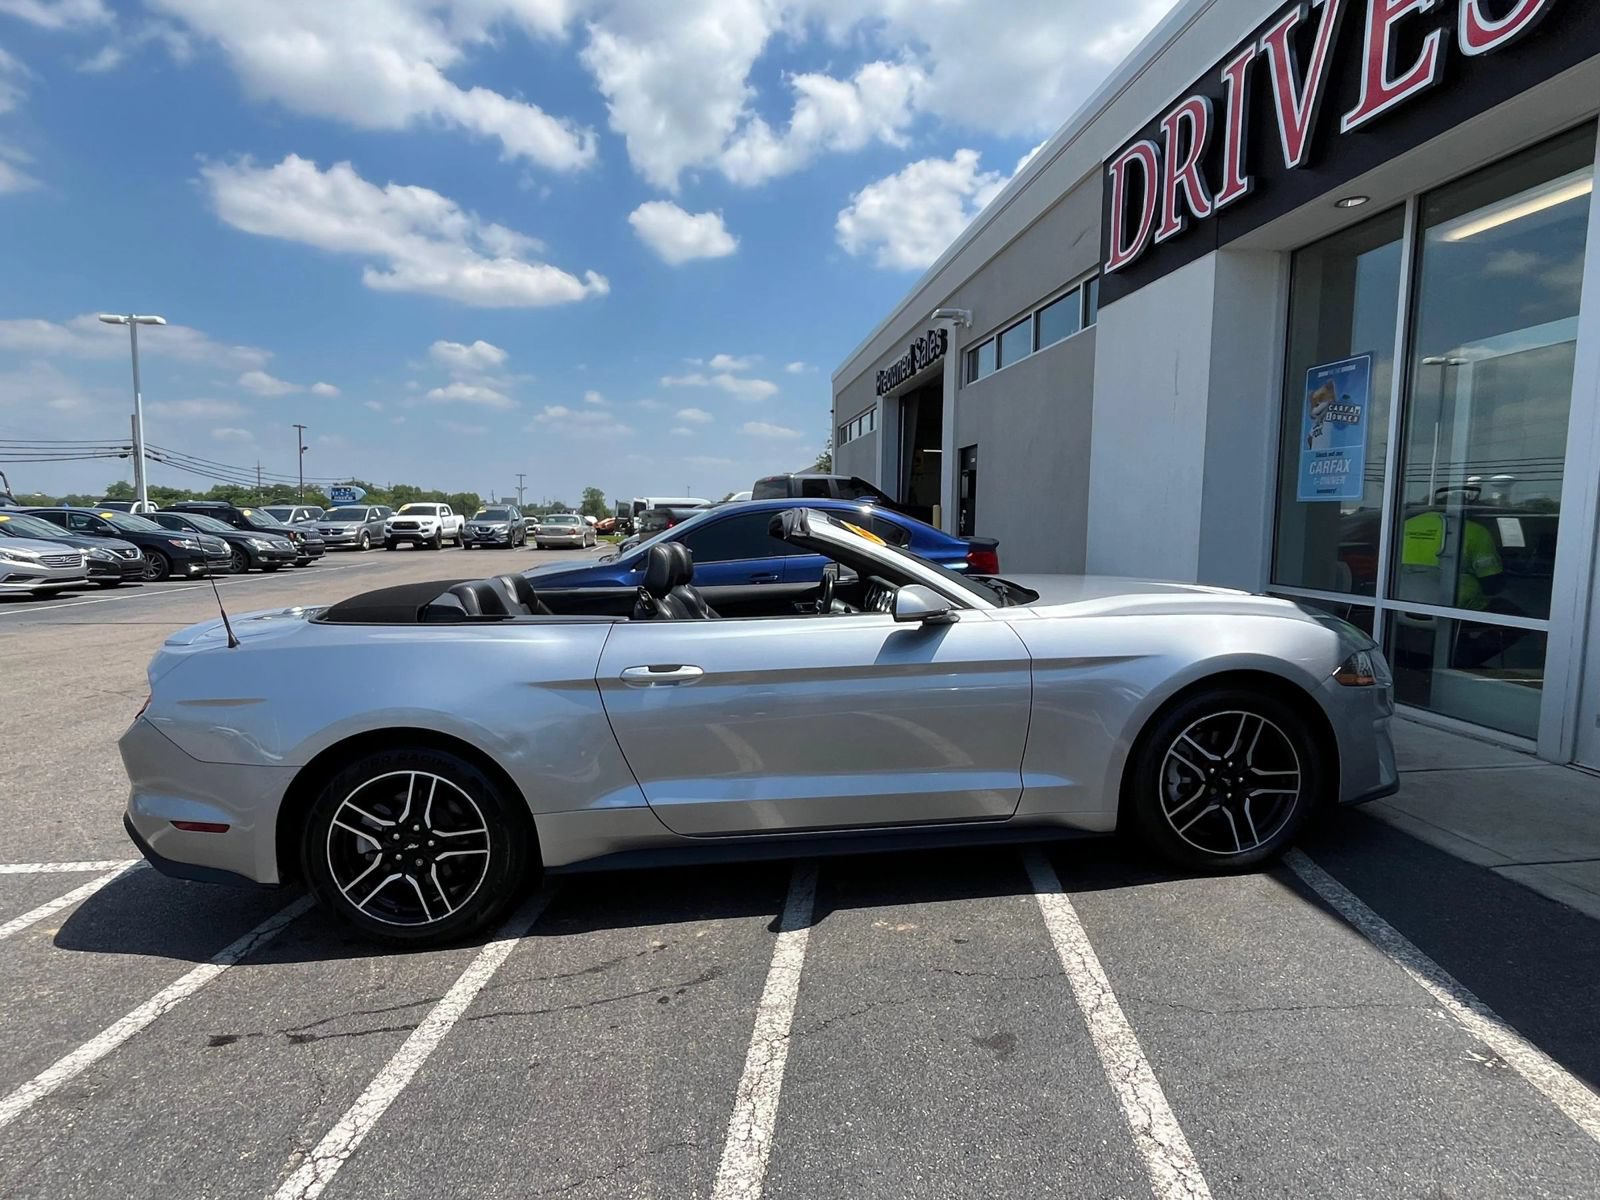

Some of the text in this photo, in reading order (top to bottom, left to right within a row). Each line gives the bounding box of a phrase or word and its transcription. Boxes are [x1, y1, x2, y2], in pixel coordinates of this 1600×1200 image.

[1104, 0, 1549, 275] DRIVE
[914, 328, 947, 369] Sales
[1309, 458, 1352, 475] CARFAX
